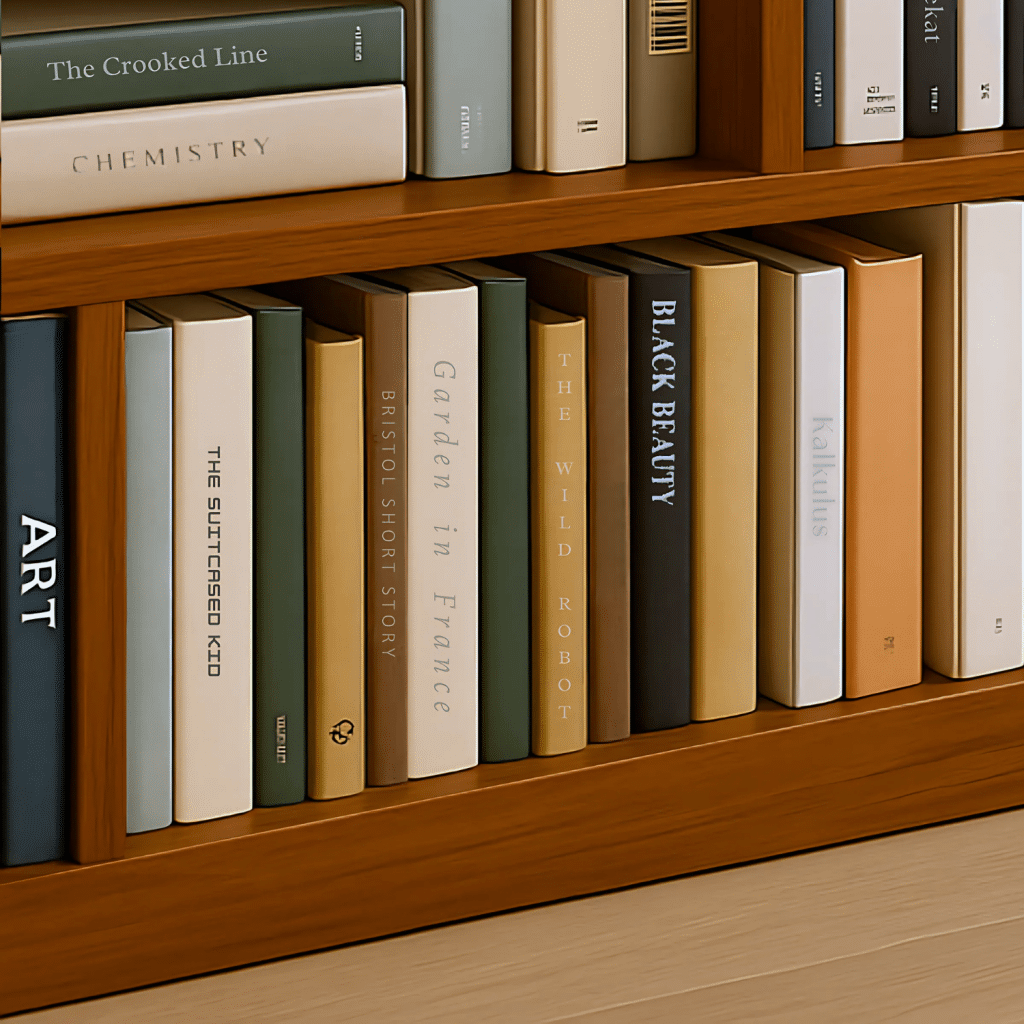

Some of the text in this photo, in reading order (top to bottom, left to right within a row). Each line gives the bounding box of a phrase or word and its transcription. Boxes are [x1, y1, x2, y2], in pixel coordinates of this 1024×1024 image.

[46, 44, 268, 82] The Crooked Line
[72, 137, 272, 174] CHEMISTRY
[651, 299, 677, 507] BLACK BEAUTY
[812, 417, 836, 537] Kalkulus
[20, 514, 57, 629] ART
[207, 446, 220, 677] THE SUITCASED KID
[381, 390, 396, 658] BRISTOL SHORT STORY
[433, 360, 459, 713] Garden in France
[555, 353, 574, 719] THE WILD ROBOT
